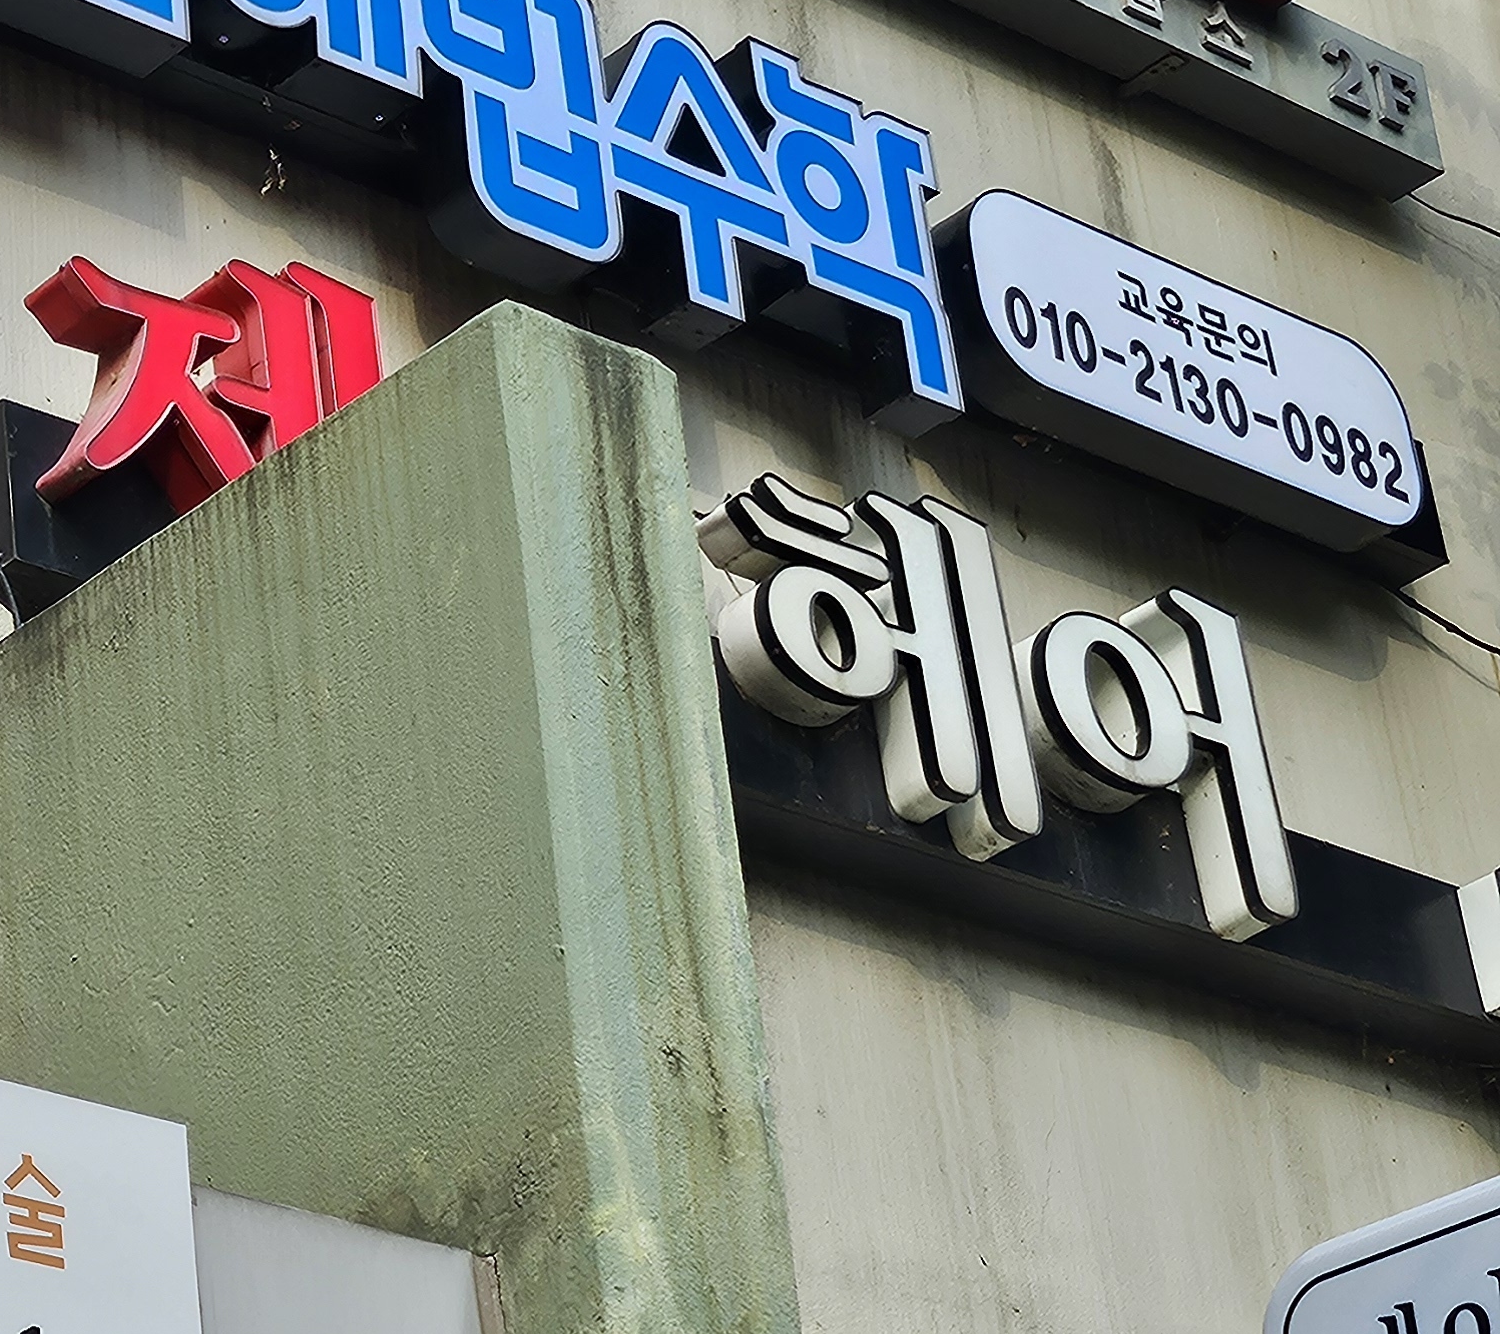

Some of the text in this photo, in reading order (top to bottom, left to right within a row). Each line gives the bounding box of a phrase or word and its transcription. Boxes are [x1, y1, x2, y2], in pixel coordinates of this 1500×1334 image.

[1320, 38, 1417, 133] 2F
[1004, 286, 1410, 505] 010-2130-0982
[1117, 270, 1278, 376] 교육문의
[715, 472, 1300, 925] 헤어
